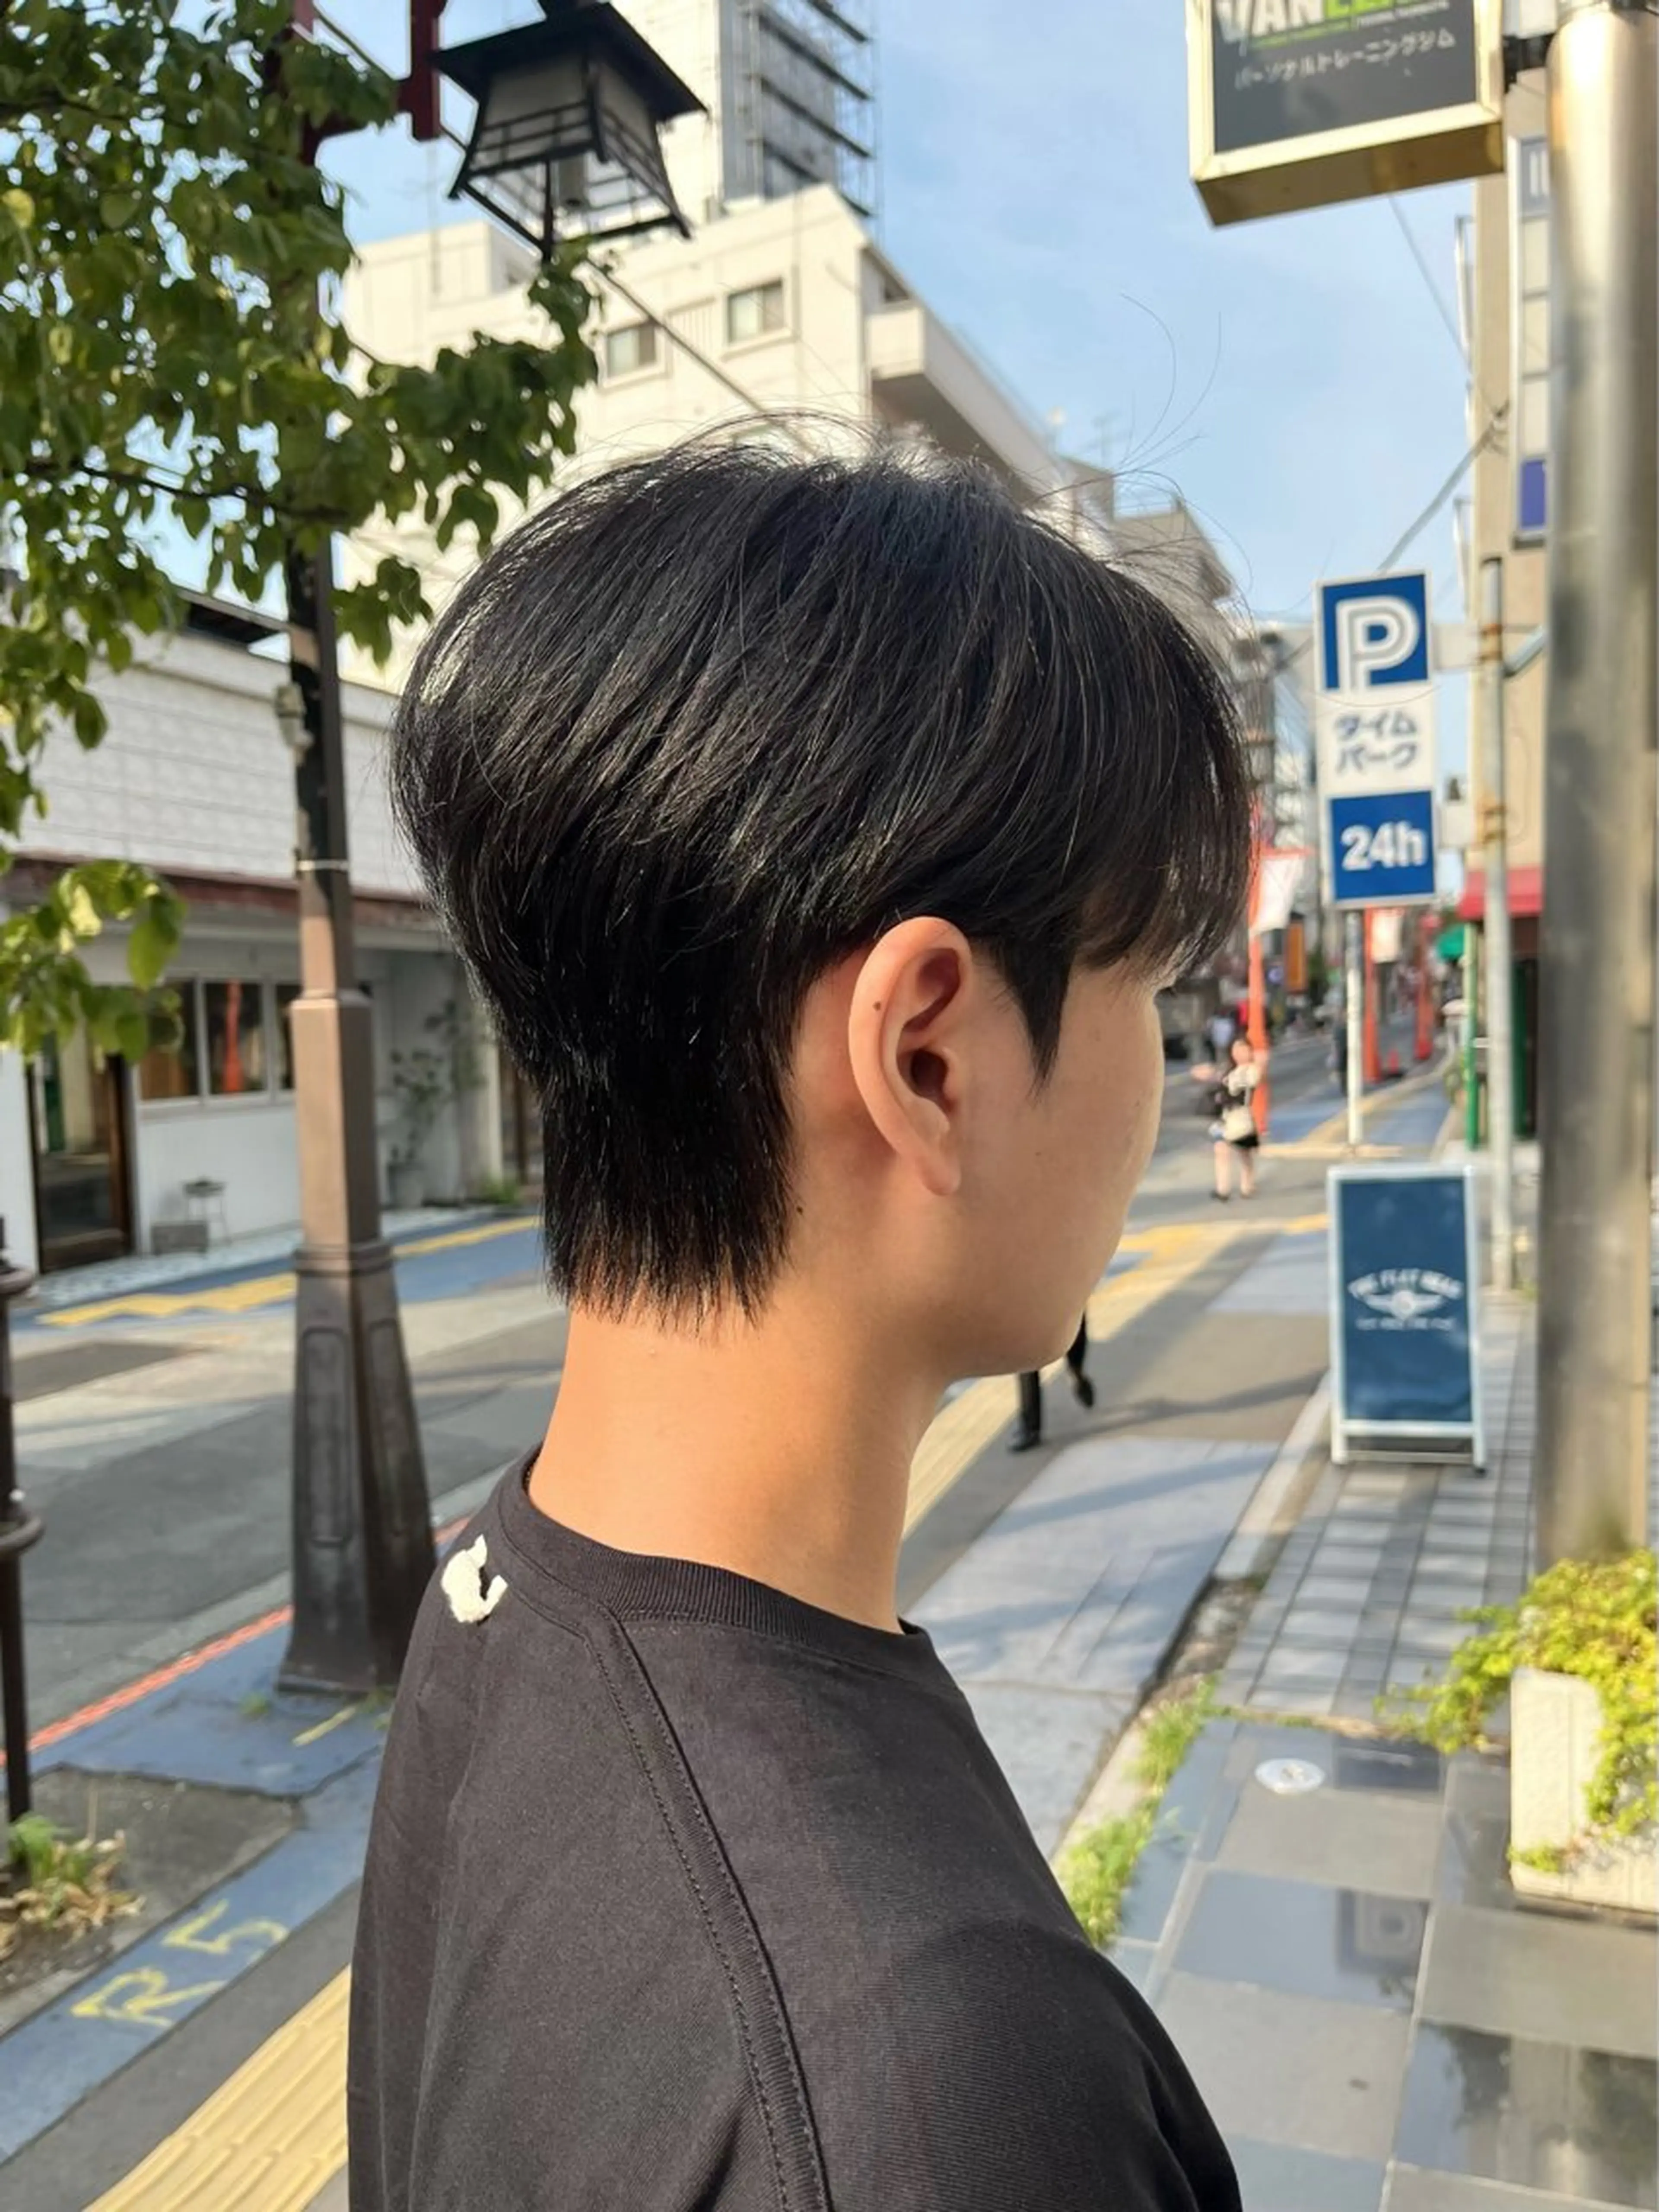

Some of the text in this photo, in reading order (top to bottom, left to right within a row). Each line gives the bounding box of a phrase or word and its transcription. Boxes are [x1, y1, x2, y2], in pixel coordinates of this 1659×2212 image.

[1335, 595, 1421, 690] P
[1335, 709, 1417, 741] タイム
[1335, 741, 1417, 776] パーク
[1341, 820, 1427, 872] 24h
